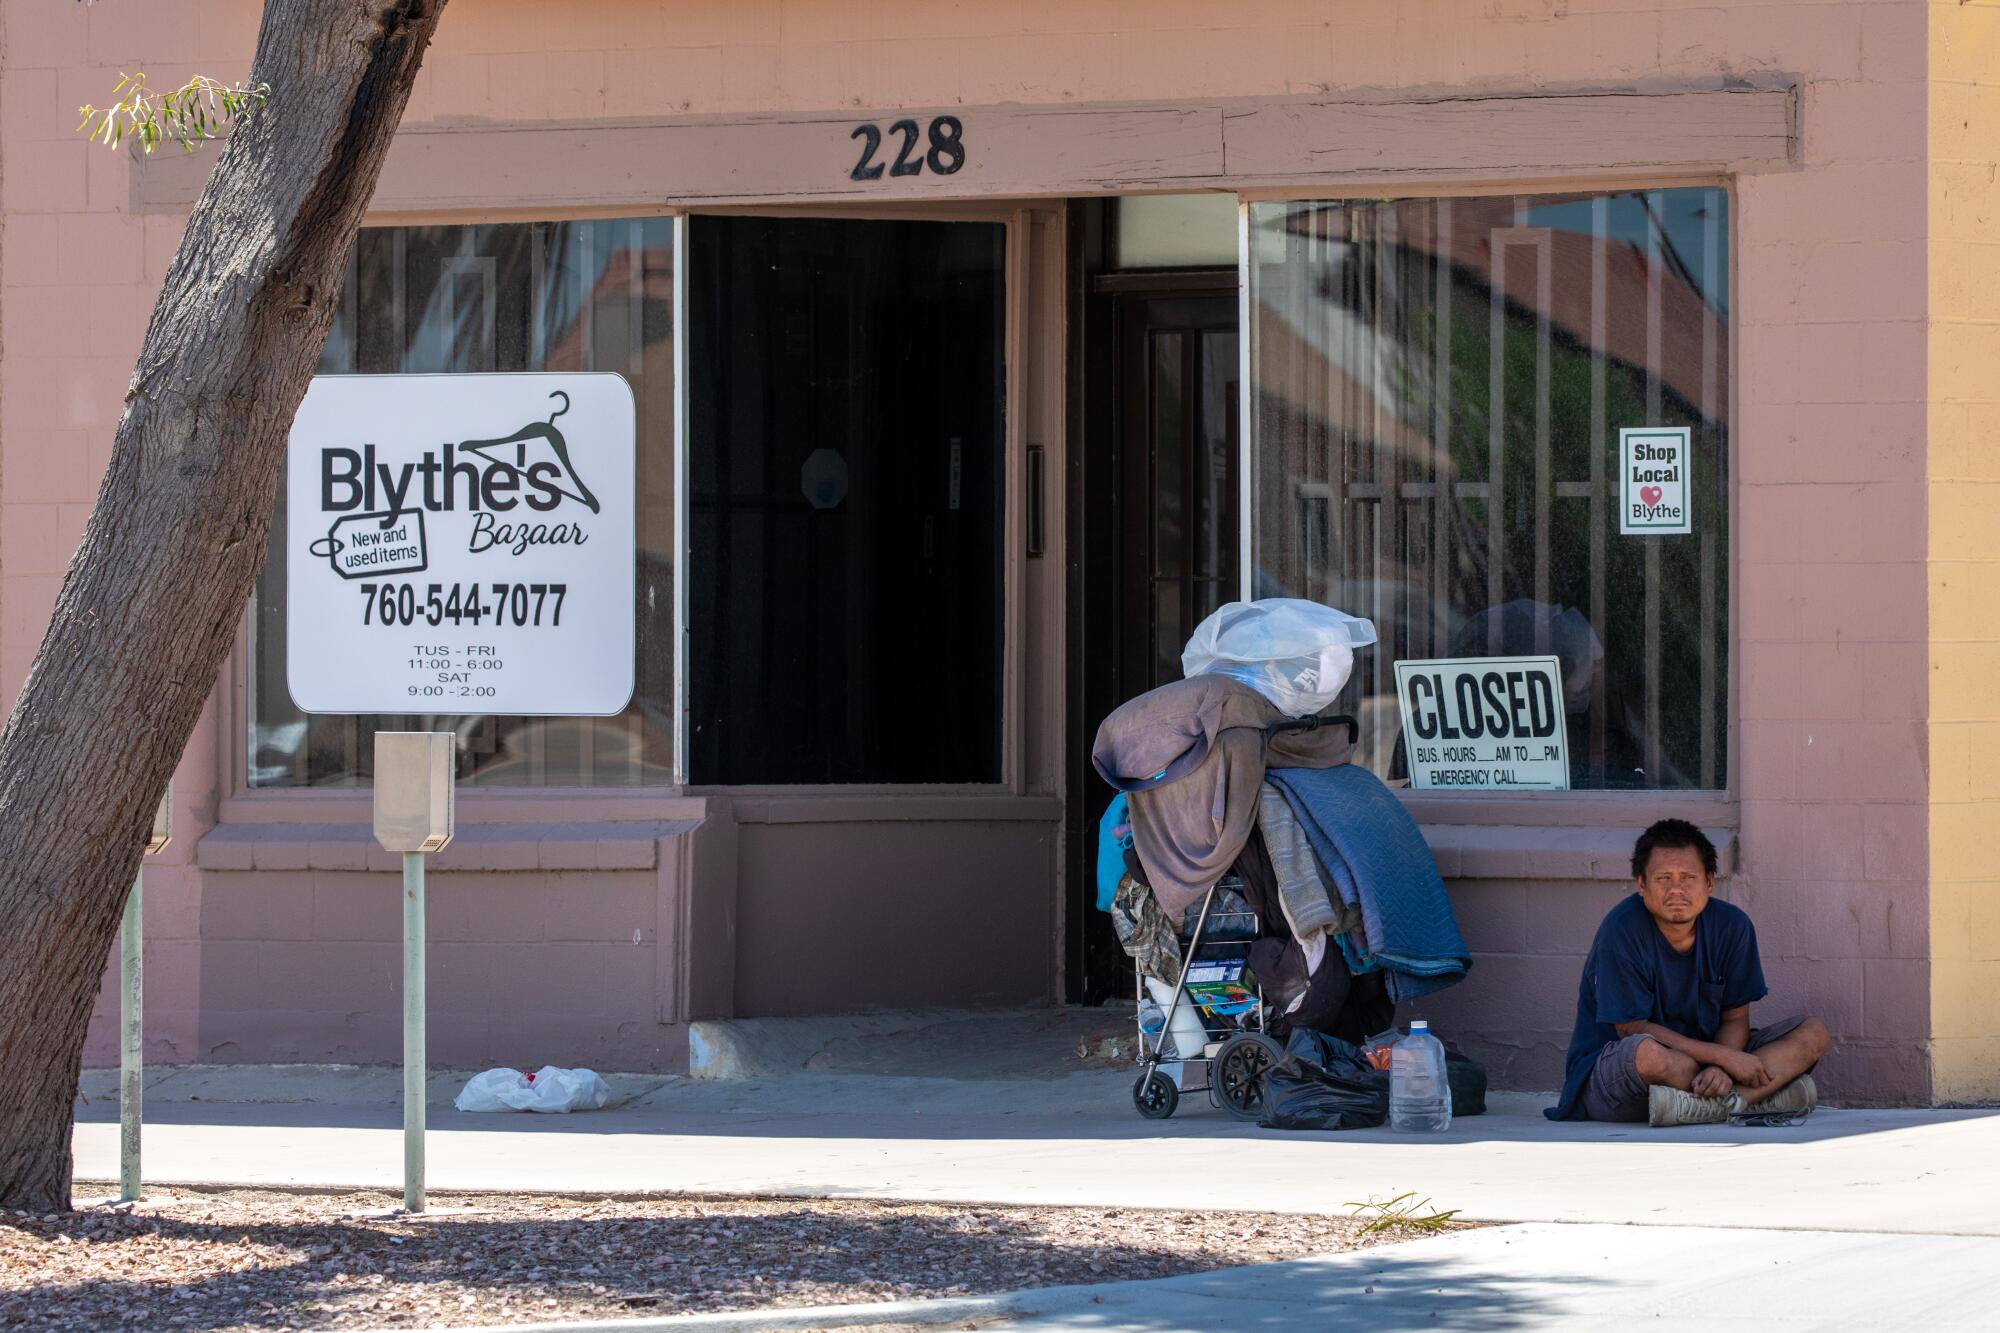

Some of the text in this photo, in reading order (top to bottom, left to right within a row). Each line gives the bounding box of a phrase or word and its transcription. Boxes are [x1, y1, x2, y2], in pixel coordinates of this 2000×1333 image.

[850, 115, 965, 181] 228
[1634, 444, 1677, 464] Shop
[1632, 466, 1679, 483] Local
[321, 443, 563, 530] Blythe's
[1632, 504, 1681, 522] Blythe
[352, 524, 407, 548] New and
[469, 512, 588, 556] Bazaar
[345, 545, 418, 568] used items
[360, 583, 567, 627] 760-544-7077
[413, 645, 450, 656] TUS
[467, 645, 496, 656] FRI
[407, 658, 451, 669] 11:00
[467, 659, 503, 670] 6:00
[437, 672, 471, 683] SAT
[407, 685, 444, 697] 9:00
[460, 686, 496, 697] 2:00
[1408, 670, 1555, 740] CLOSED
[1417, 745, 1559, 763] BUS. HOURS AM TO PM
[1430, 769, 1519, 786] EMERGENCY CALL
